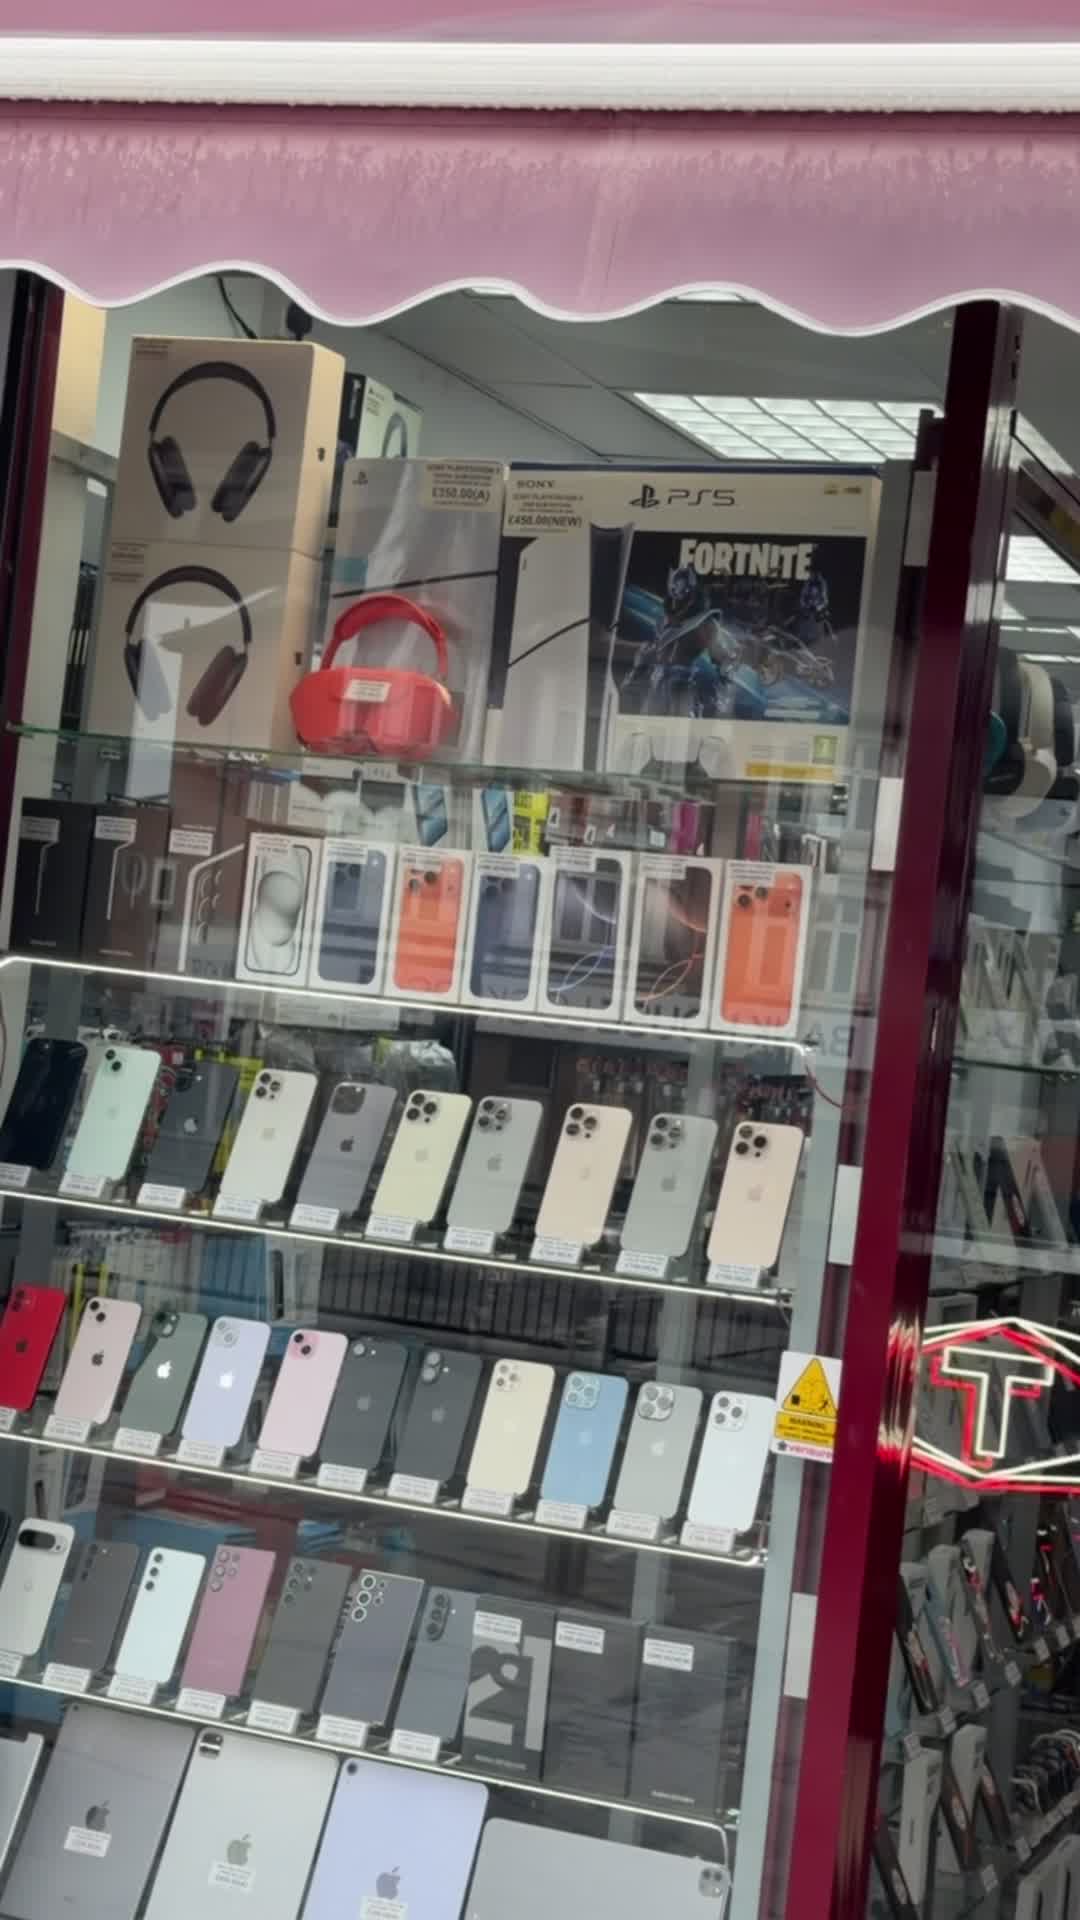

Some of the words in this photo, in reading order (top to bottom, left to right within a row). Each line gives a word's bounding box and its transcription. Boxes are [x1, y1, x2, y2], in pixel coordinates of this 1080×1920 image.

[517, 480, 555, 488] SONY
[667, 488, 736, 507] PS5
[678, 538, 814, 580] FORTNITE
